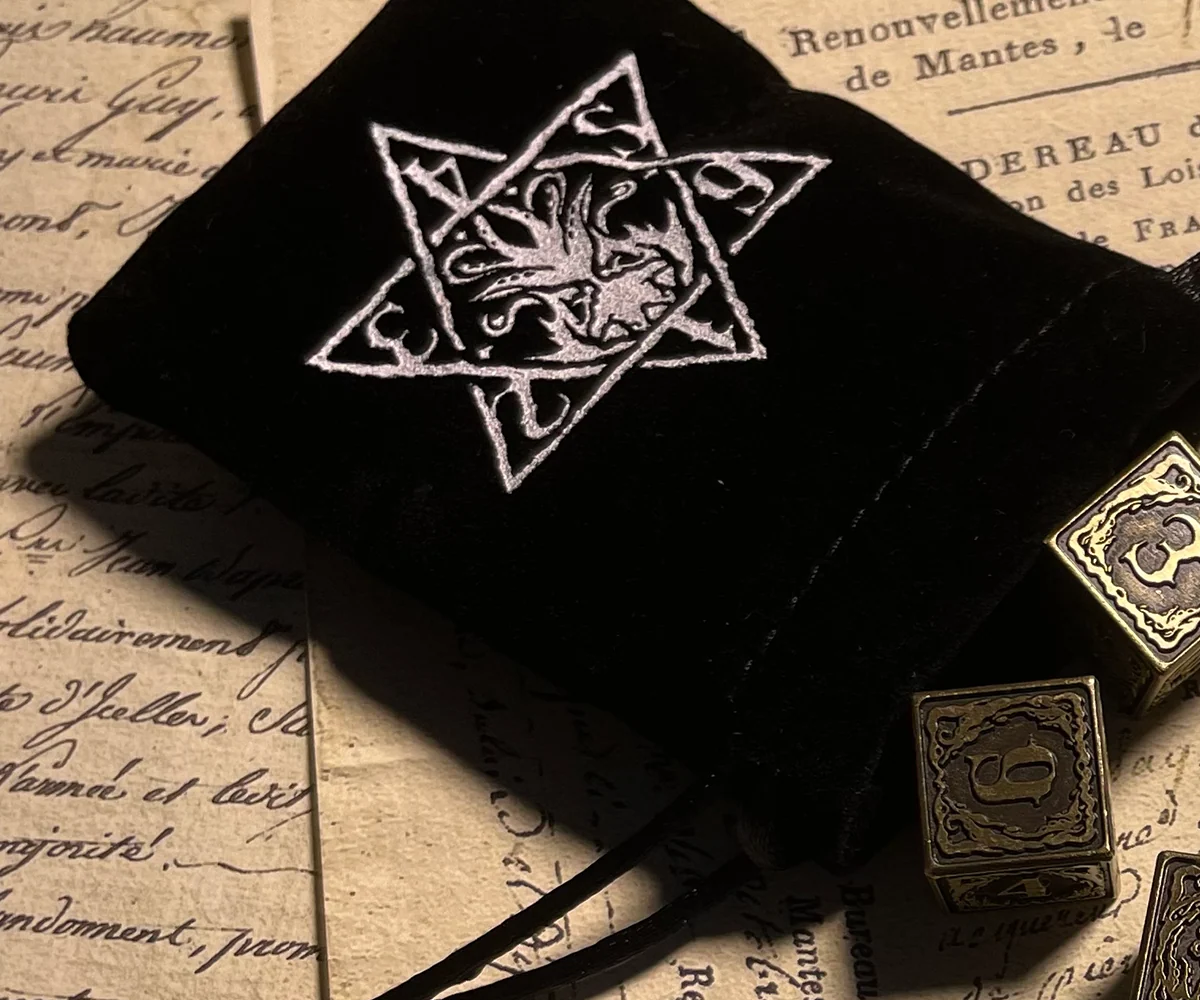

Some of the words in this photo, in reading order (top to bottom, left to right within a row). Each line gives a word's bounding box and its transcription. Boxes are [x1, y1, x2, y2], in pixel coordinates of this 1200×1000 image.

[846, 65, 891, 93] de
[1110, 16, 1146, 43] le
[1067, 178, 1120, 203] des
[838, 881, 883, 1000] Bureau
